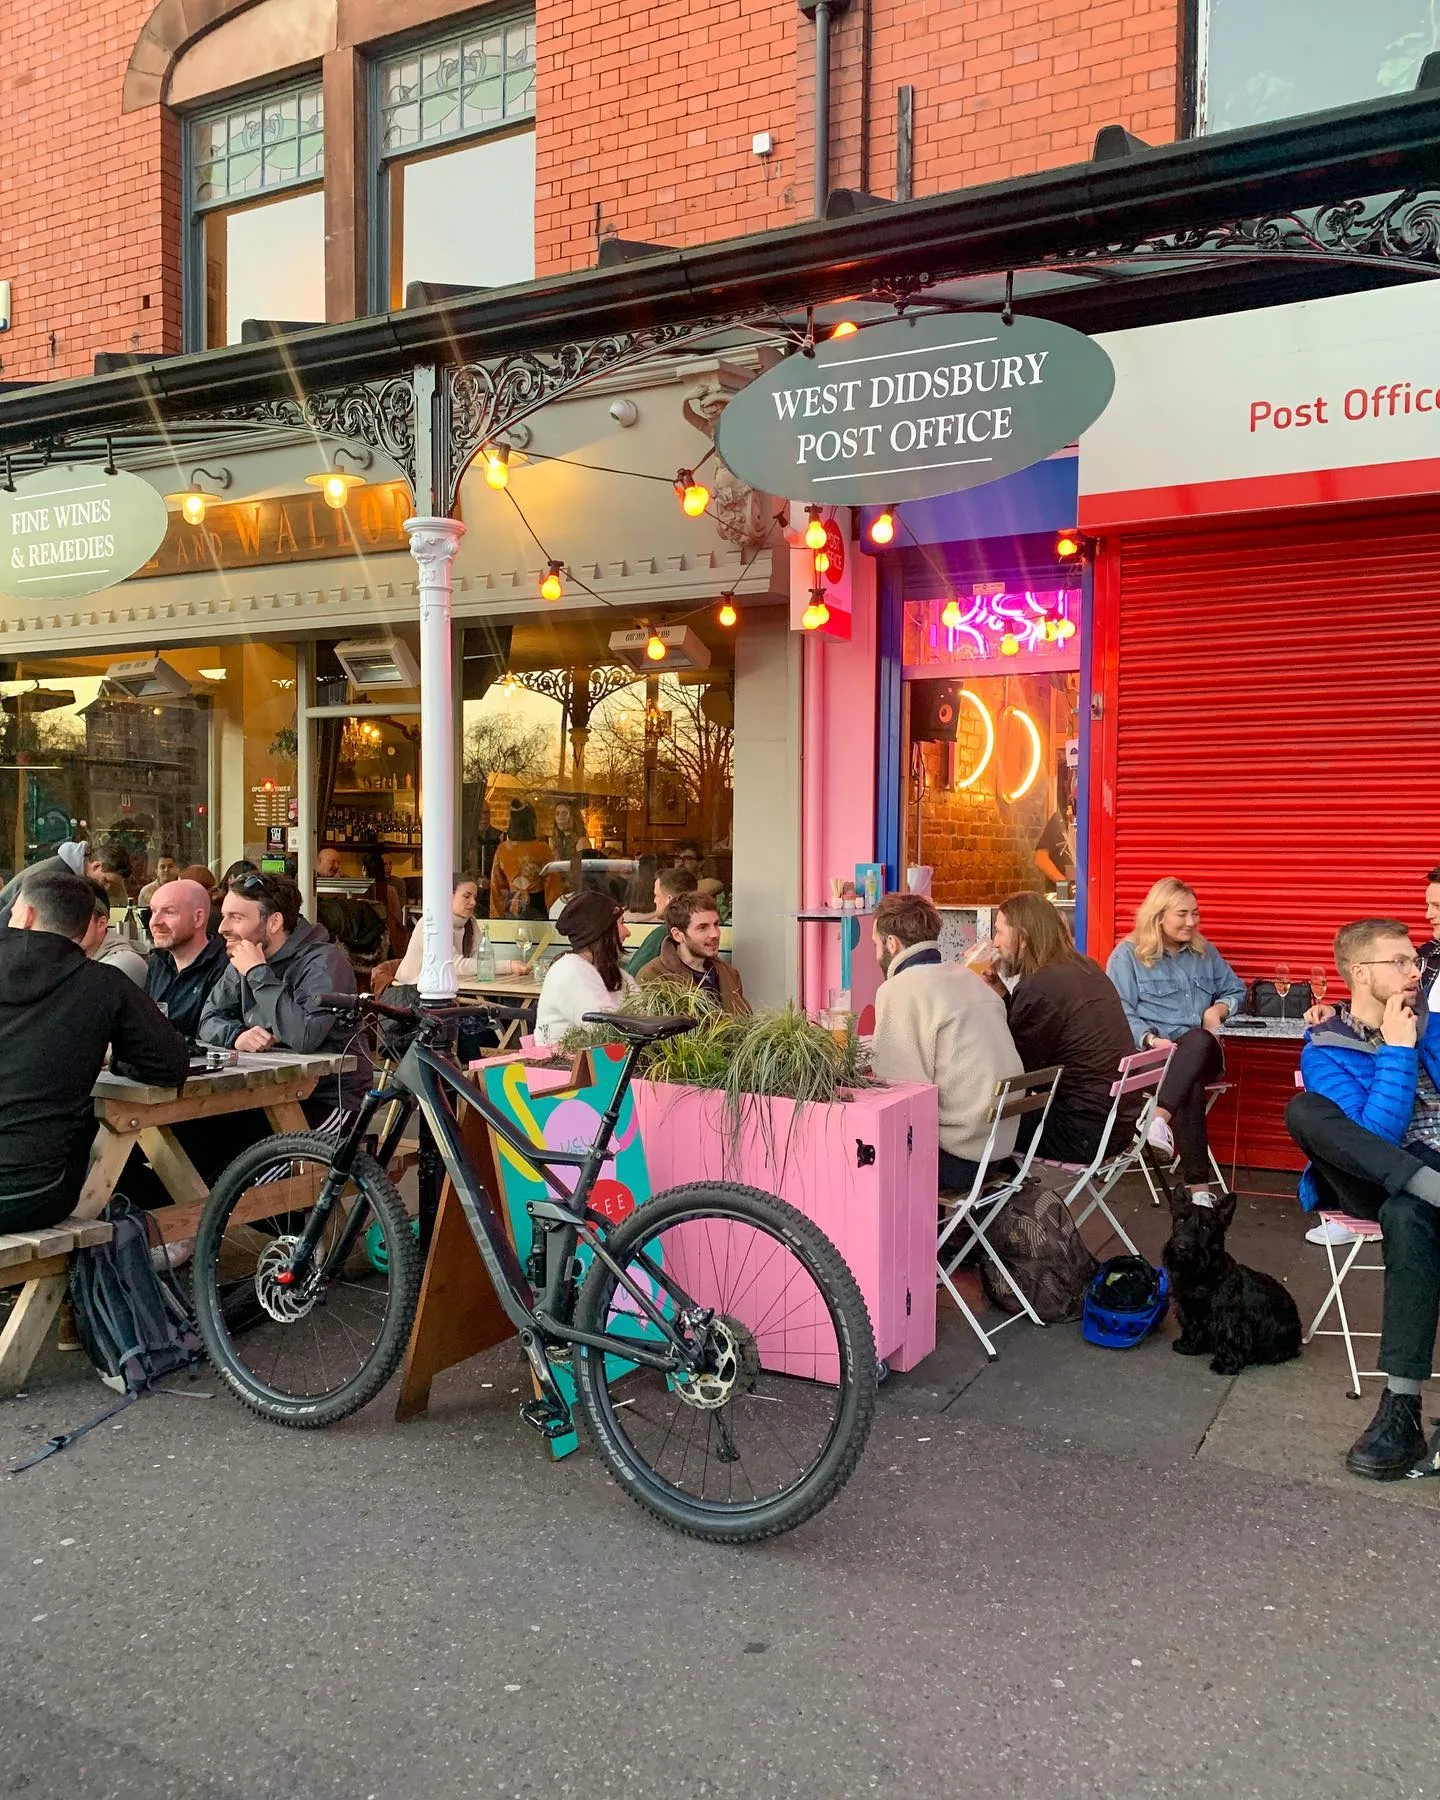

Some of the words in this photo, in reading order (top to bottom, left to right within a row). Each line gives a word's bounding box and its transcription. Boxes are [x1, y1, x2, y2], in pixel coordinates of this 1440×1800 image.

[772, 380, 861, 421] WEST
[869, 351, 1049, 409] DIDSBURY
[1250, 397, 1328, 433] Post
[1344, 382, 1440, 420] Offic
[797, 424, 882, 465] POST
[890, 407, 1013, 453] OFFICE
[11, 508, 50, 535] FINE
[54, 499, 111, 529] WINES
[11, 547, 25, 569] &
[28, 534, 114, 567] REMEDIES
[177, 531, 223, 566] AND
[580, 1359, 636, 1481] SCHWALBE
